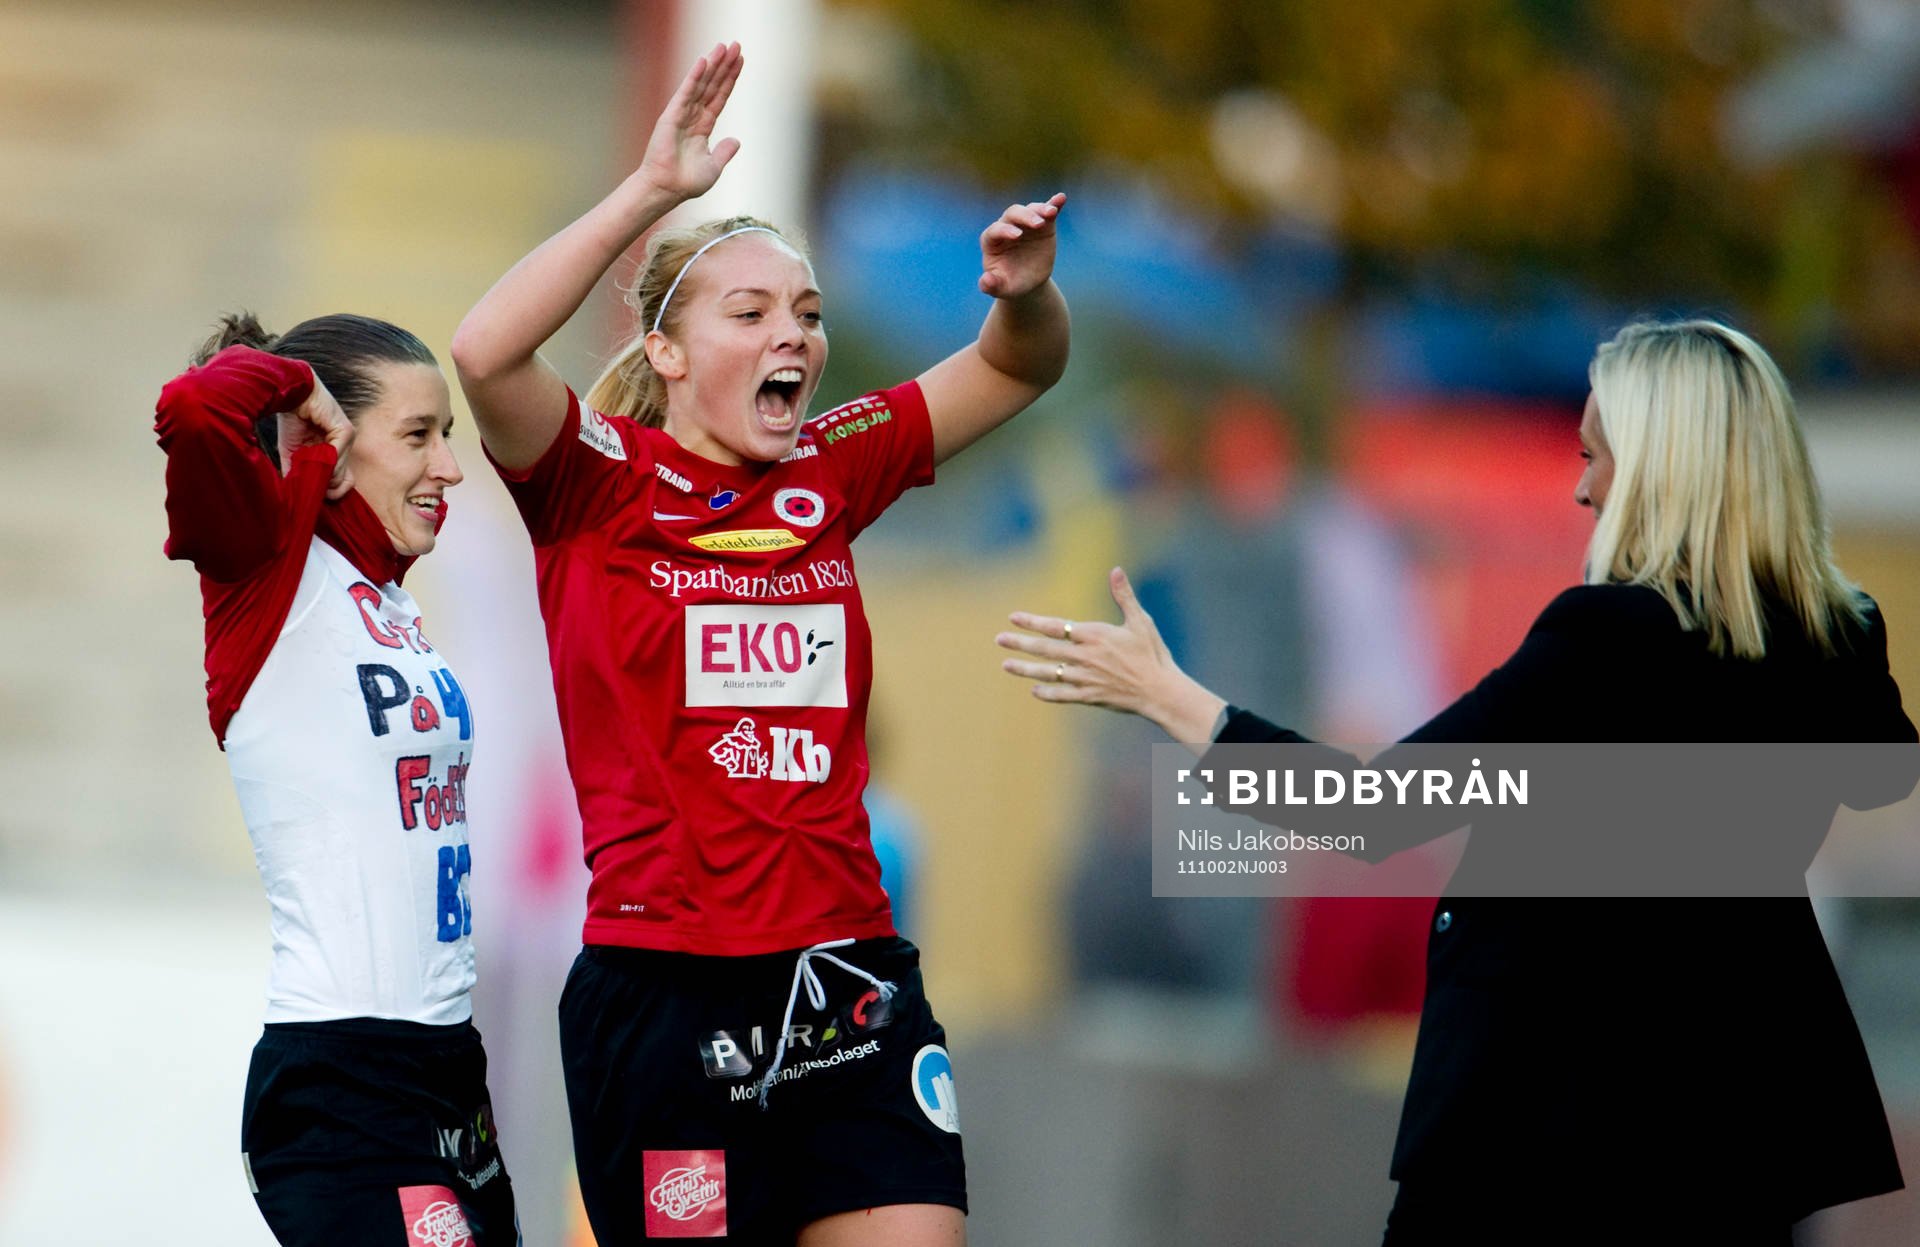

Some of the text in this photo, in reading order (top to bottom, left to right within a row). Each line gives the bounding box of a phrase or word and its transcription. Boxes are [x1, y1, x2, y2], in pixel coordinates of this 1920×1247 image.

[824, 409, 892, 445] KONSUM
[650, 559, 854, 598] Sparbanken 1826
[701, 622, 802, 674] EKO
[356, 663, 440, 737] På
[722, 680, 745, 689] Alltid
[756, 680, 768, 689] bra
[769, 726, 832, 783] Kb
[712, 1039, 737, 1069] P
